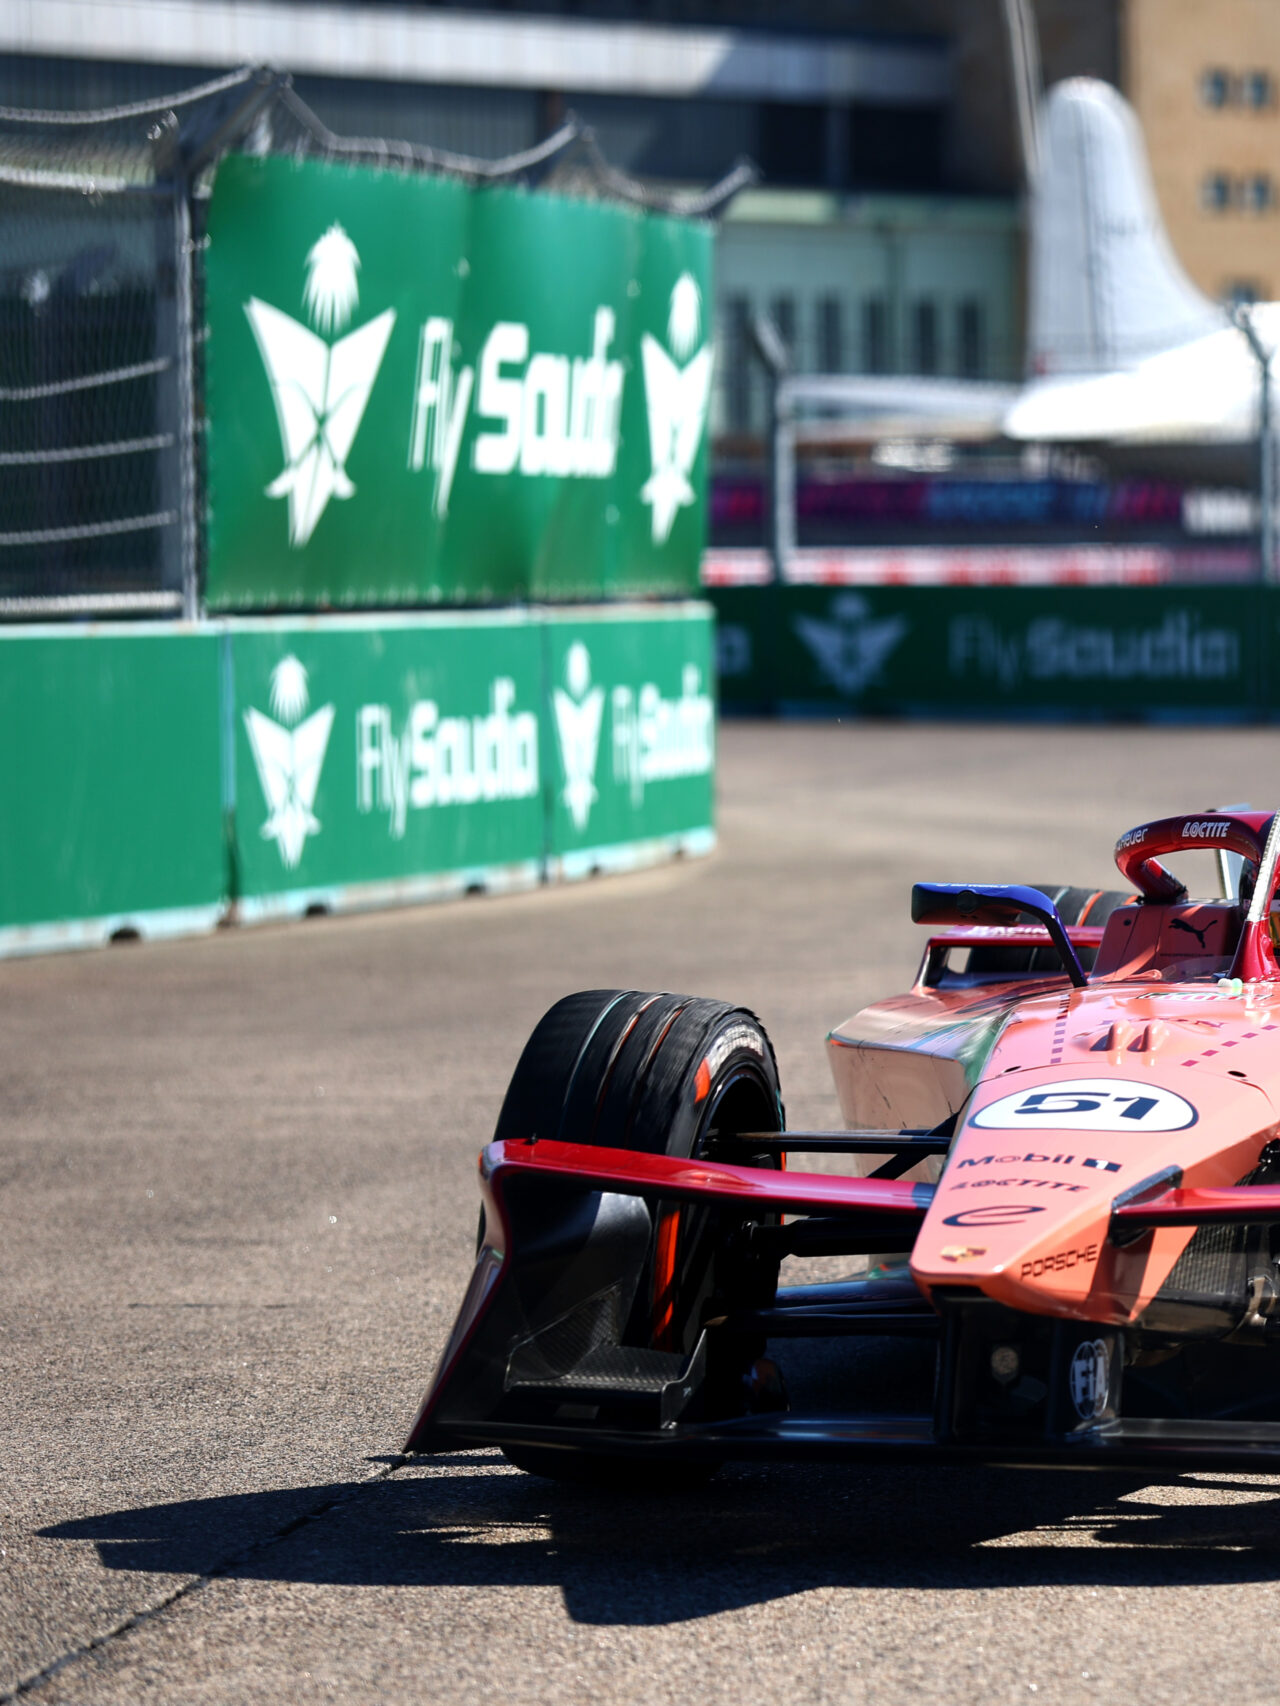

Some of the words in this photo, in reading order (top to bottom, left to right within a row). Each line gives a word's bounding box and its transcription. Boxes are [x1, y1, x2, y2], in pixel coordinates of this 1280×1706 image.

[948, 610, 1239, 690] FlySaudia
[354, 675, 540, 840] FlySaudia
[1181, 821, 1231, 838] LOCTITE
[1014, 1092, 1160, 1120] 51
[956, 1153, 1075, 1169] Mobil
[948, 1179, 1090, 1193] LOCTITE
[1020, 1244, 1099, 1280] PORSCHE
